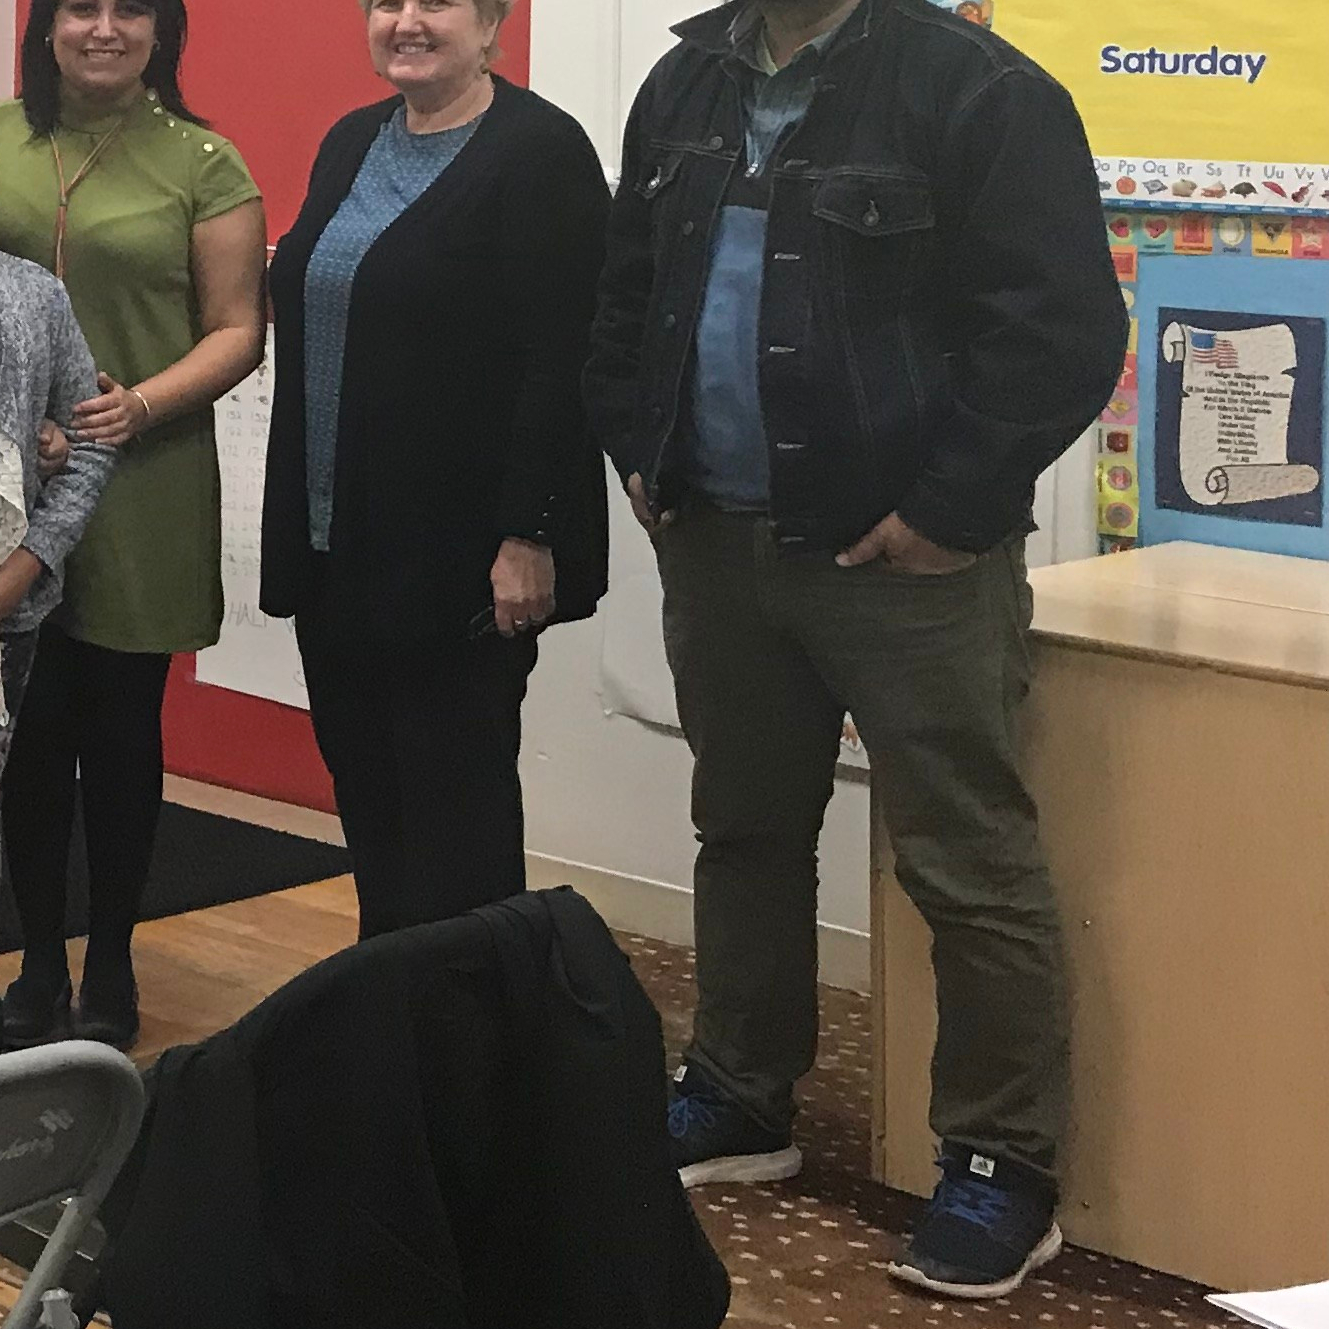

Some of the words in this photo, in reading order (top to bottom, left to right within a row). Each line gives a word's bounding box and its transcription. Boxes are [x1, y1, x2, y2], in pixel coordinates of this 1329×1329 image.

[1100, 46, 1267, 84] Saturday
[1118, 160, 1136, 175] Pp
[1143, 160, 1168, 178] Qq
[1177, 162, 1193, 175] Rr
[1264, 165, 1284, 180] Uu
[1295, 167, 1315, 180] Vv
